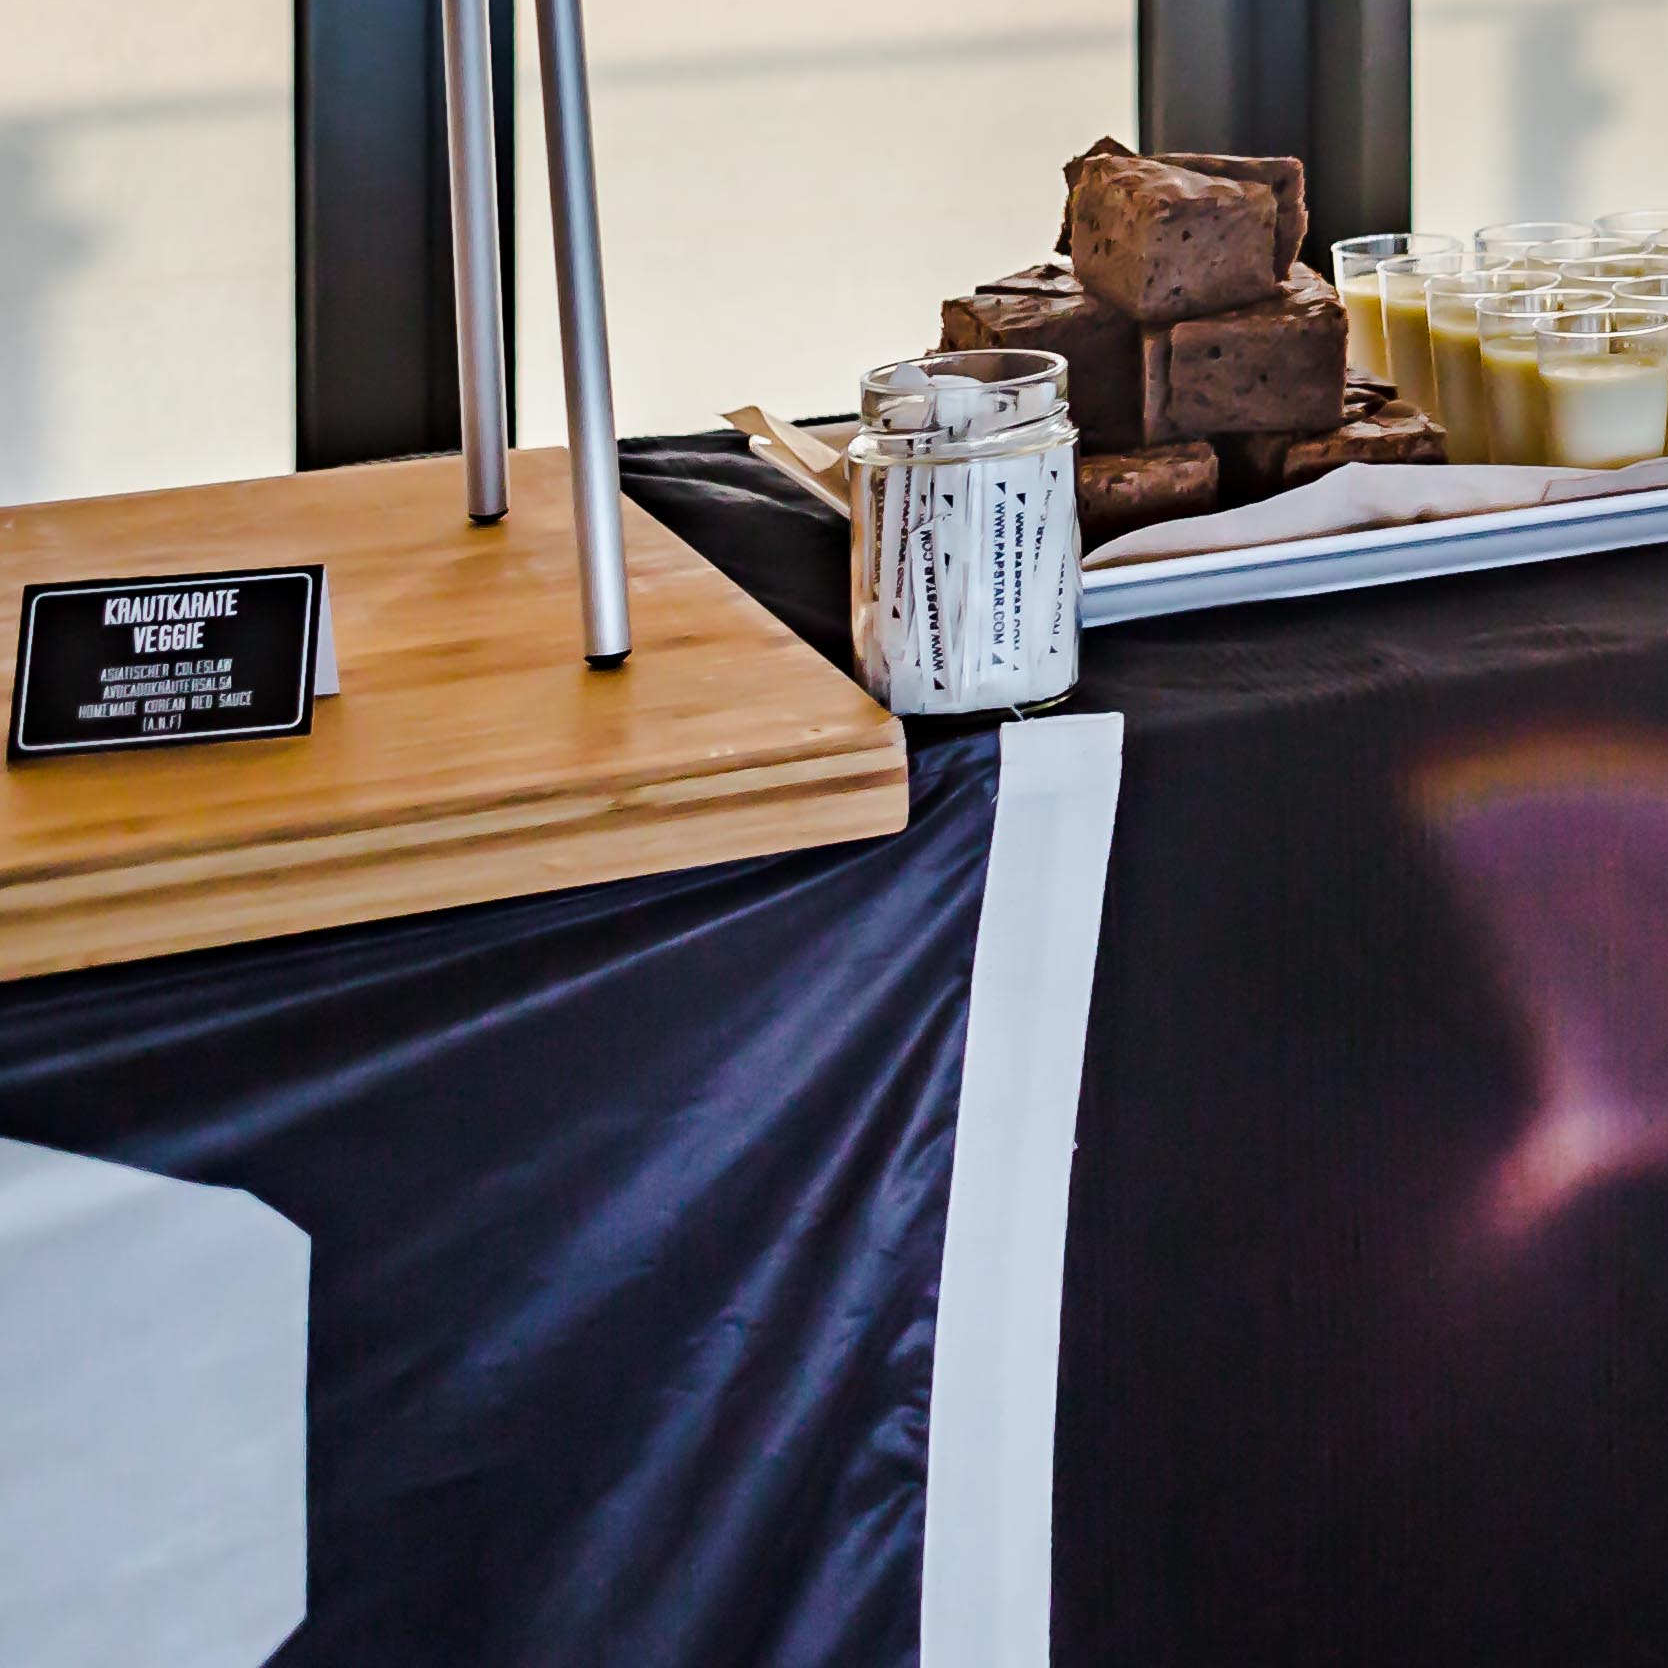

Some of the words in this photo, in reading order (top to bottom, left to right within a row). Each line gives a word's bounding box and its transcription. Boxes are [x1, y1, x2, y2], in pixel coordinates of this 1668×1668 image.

[993, 500, 1006, 645] WWW.PAPSTAR.COM
[104, 588, 240, 625] KRAUTKARATE
[919, 529, 945, 672] WWW.PAPSTAR.COM
[133, 621, 206, 654] VEGGIE
[217, 690, 253, 708] SAUCE
